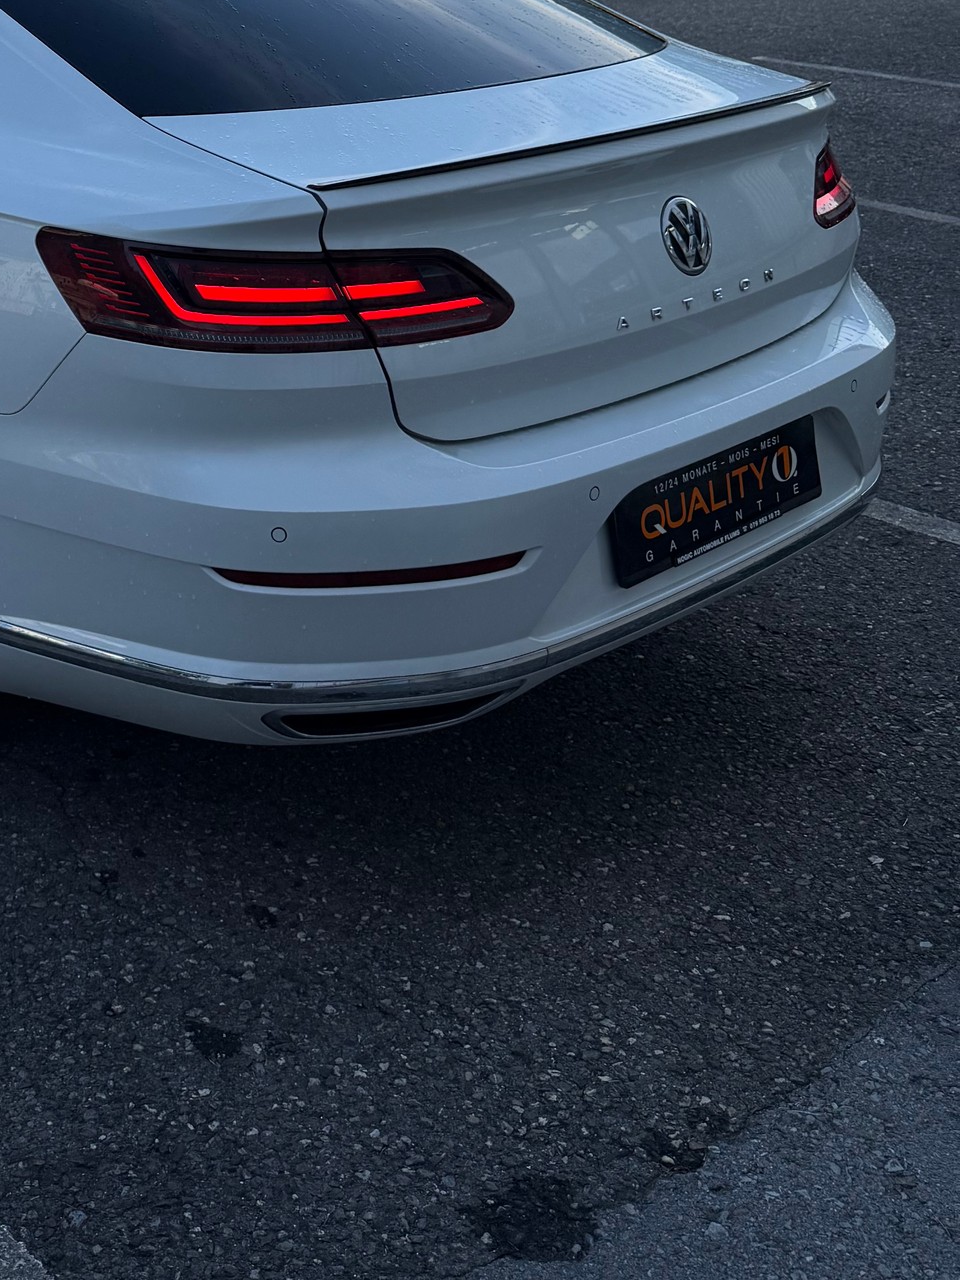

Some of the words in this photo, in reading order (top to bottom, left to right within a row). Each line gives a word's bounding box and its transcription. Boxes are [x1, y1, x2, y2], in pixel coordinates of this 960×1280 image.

[617, 268, 774, 331] ARTEON
[640, 456, 769, 540] QUALITY
[654, 477, 679, 494] 12/24
[682, 461, 718, 483] MONATE
[728, 447, 750, 464] MOIS
[760, 434, 780, 450] MESI
[645, 483, 800, 563] GARANTIE
